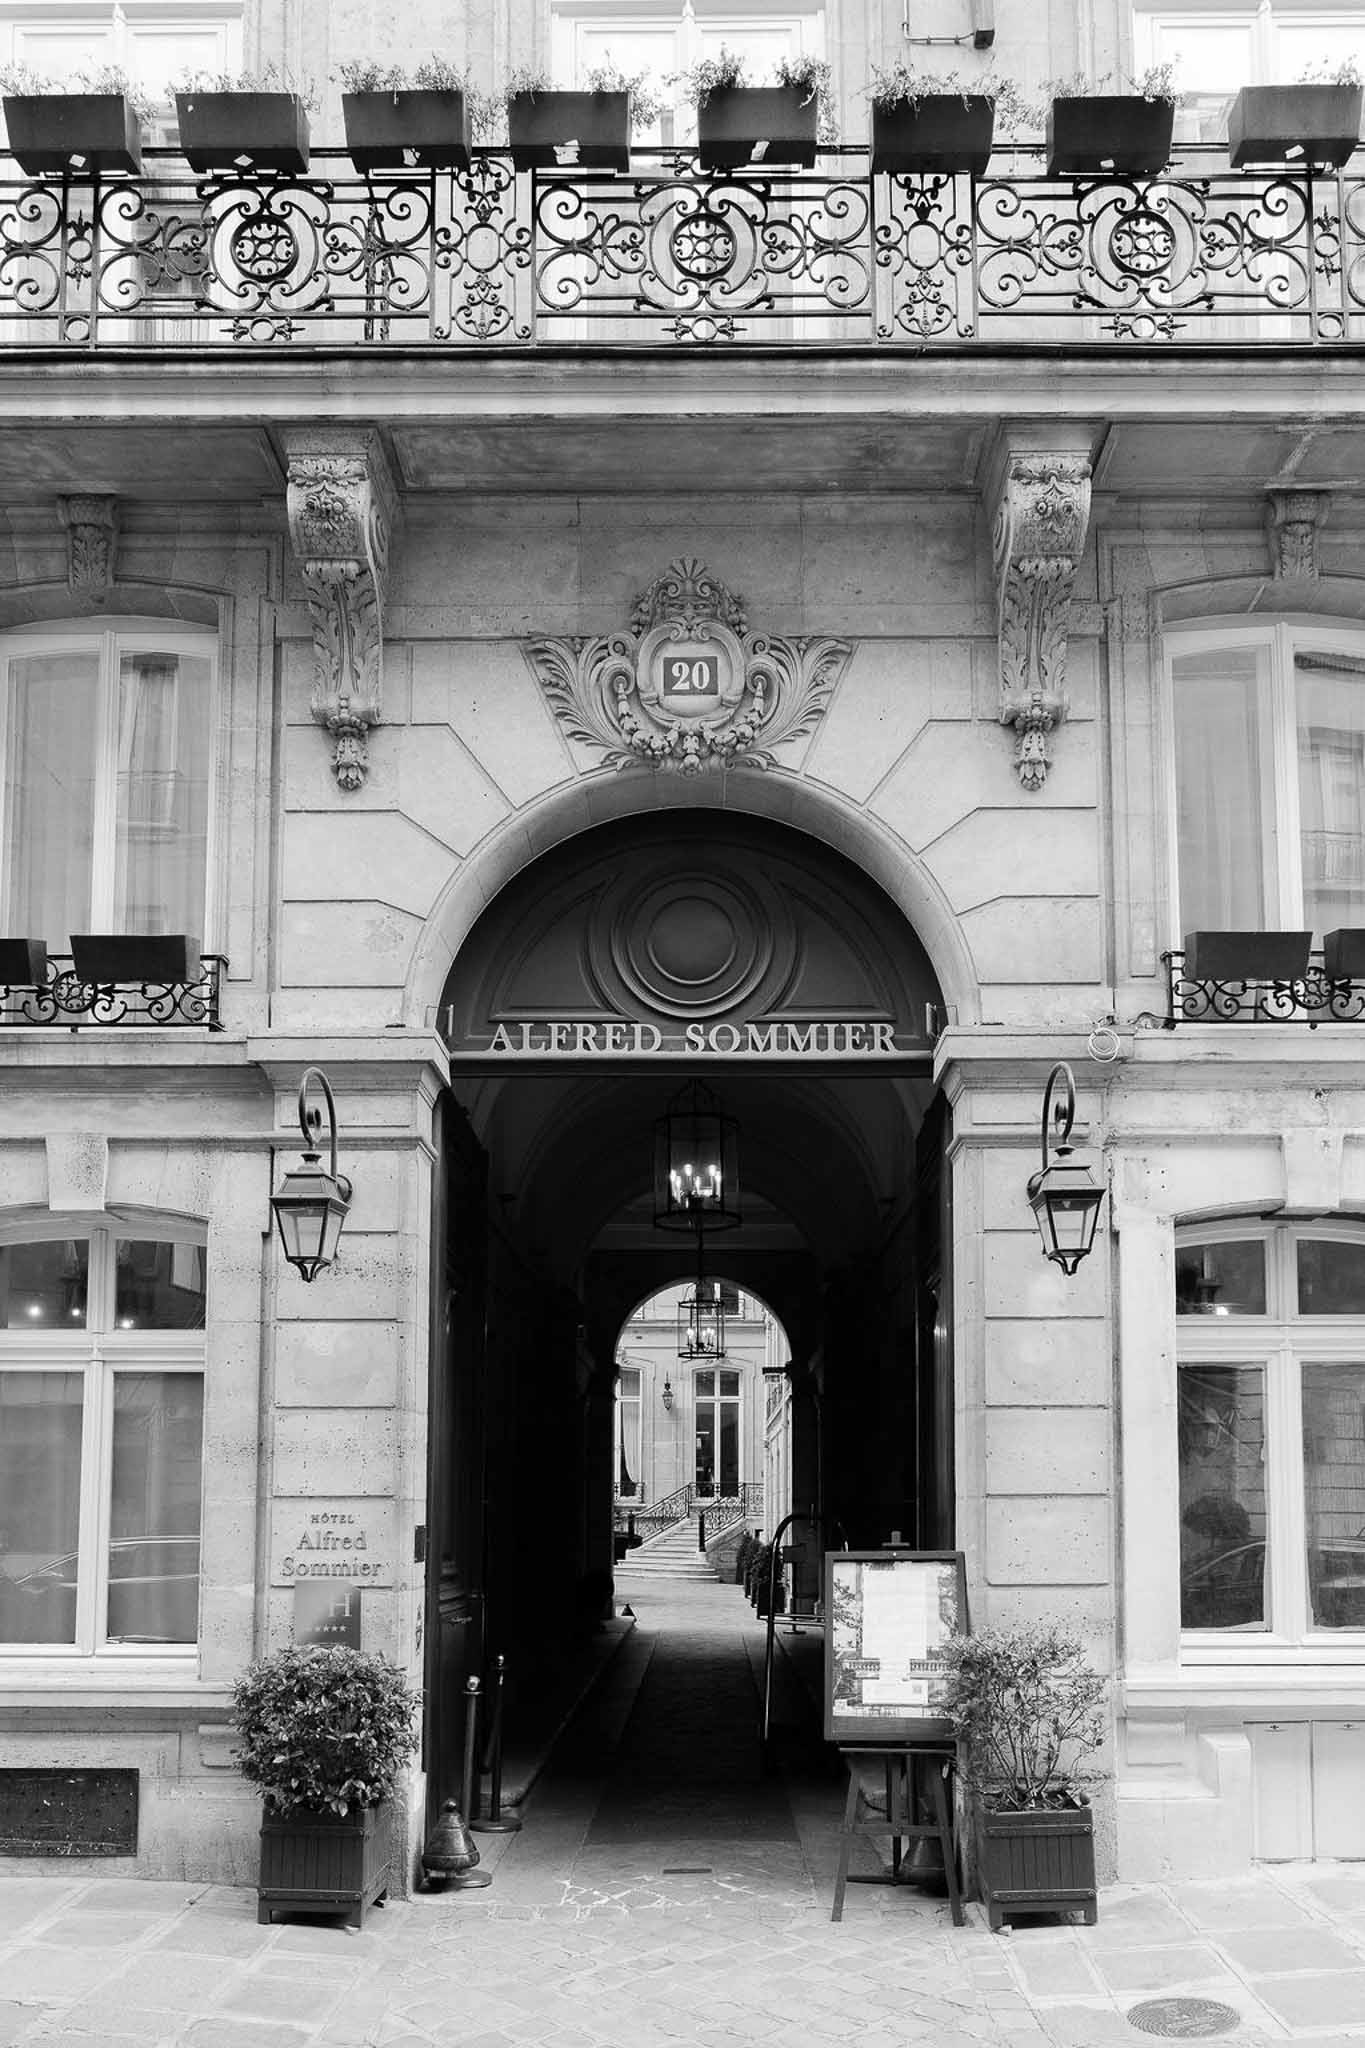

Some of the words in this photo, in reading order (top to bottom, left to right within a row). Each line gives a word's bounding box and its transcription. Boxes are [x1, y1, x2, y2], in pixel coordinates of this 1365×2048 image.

[671, 661, 710, 690] 20
[489, 1022, 662, 1052] ALFRED
[685, 1022, 898, 1052] SOMMIER
[311, 1512, 355, 1524] HÔTEL
[296, 1530, 368, 1551] Alfred
[282, 1556, 382, 1577] Sommier
[328, 1592, 352, 1617] H
